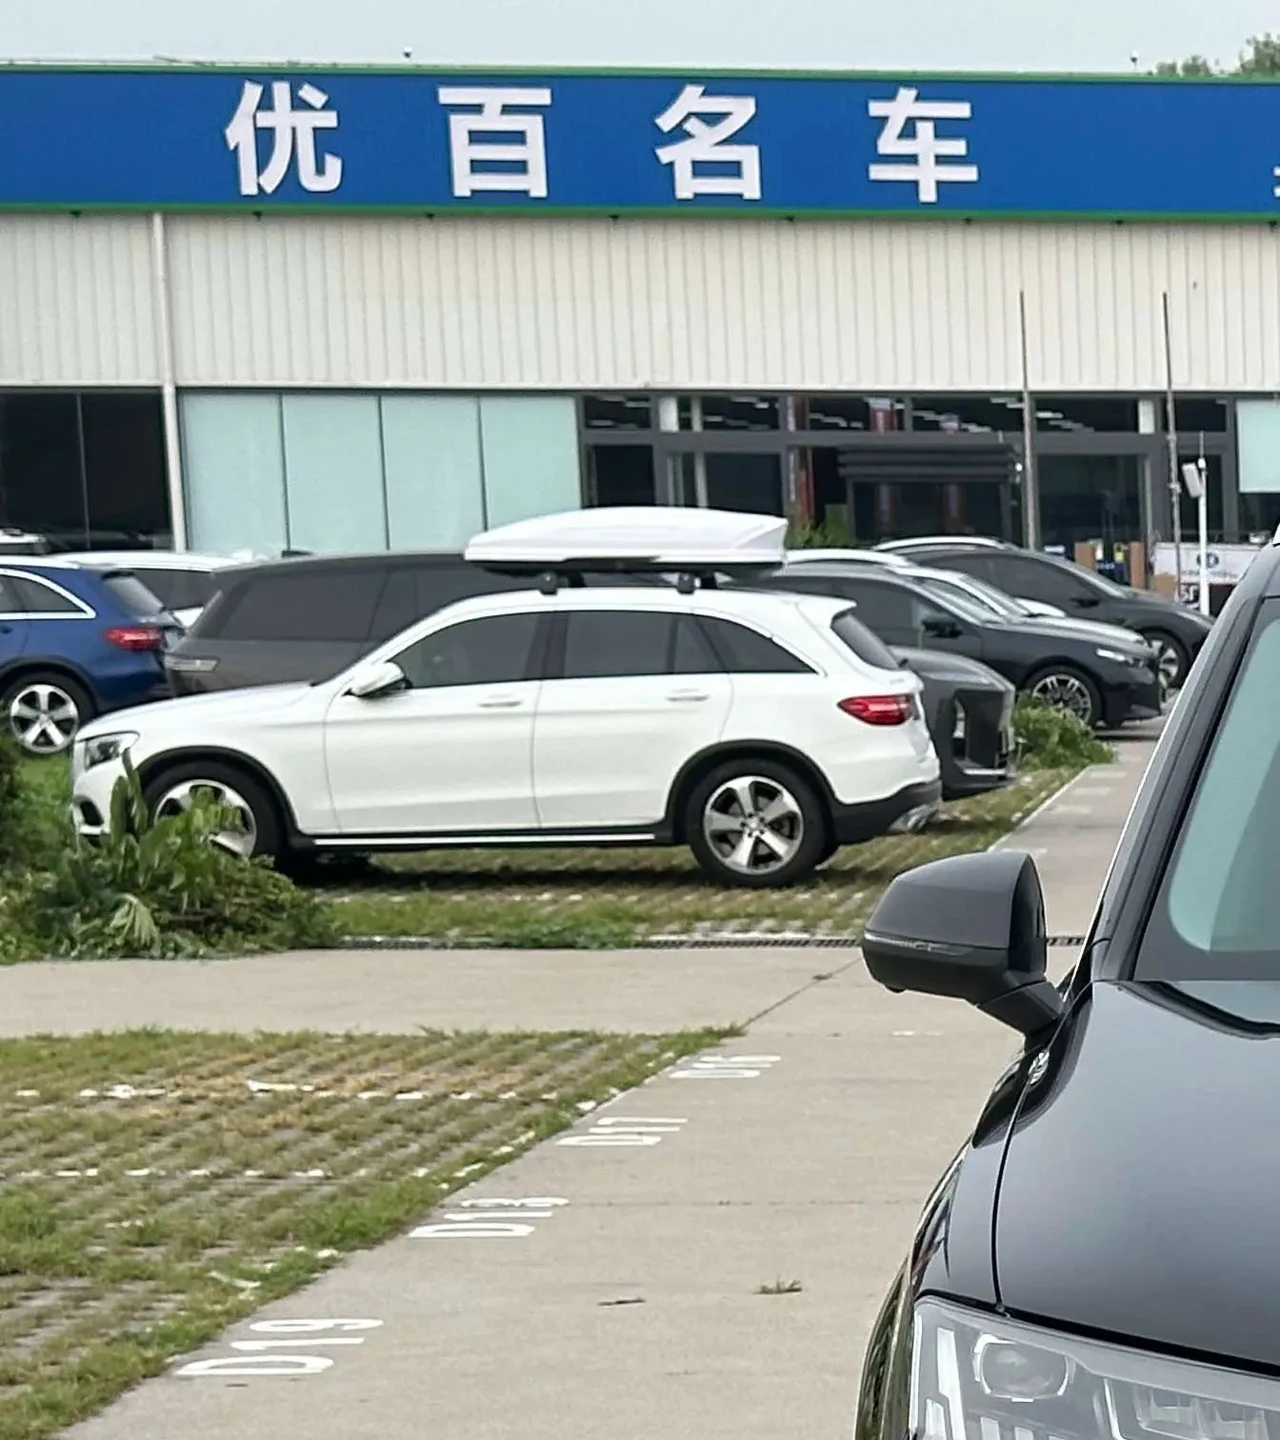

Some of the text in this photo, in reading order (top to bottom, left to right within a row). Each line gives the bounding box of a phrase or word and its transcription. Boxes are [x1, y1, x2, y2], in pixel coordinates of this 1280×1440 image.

[225, 81, 978, 203] 优百名车
[175, 1318, 384, 1375] D19
